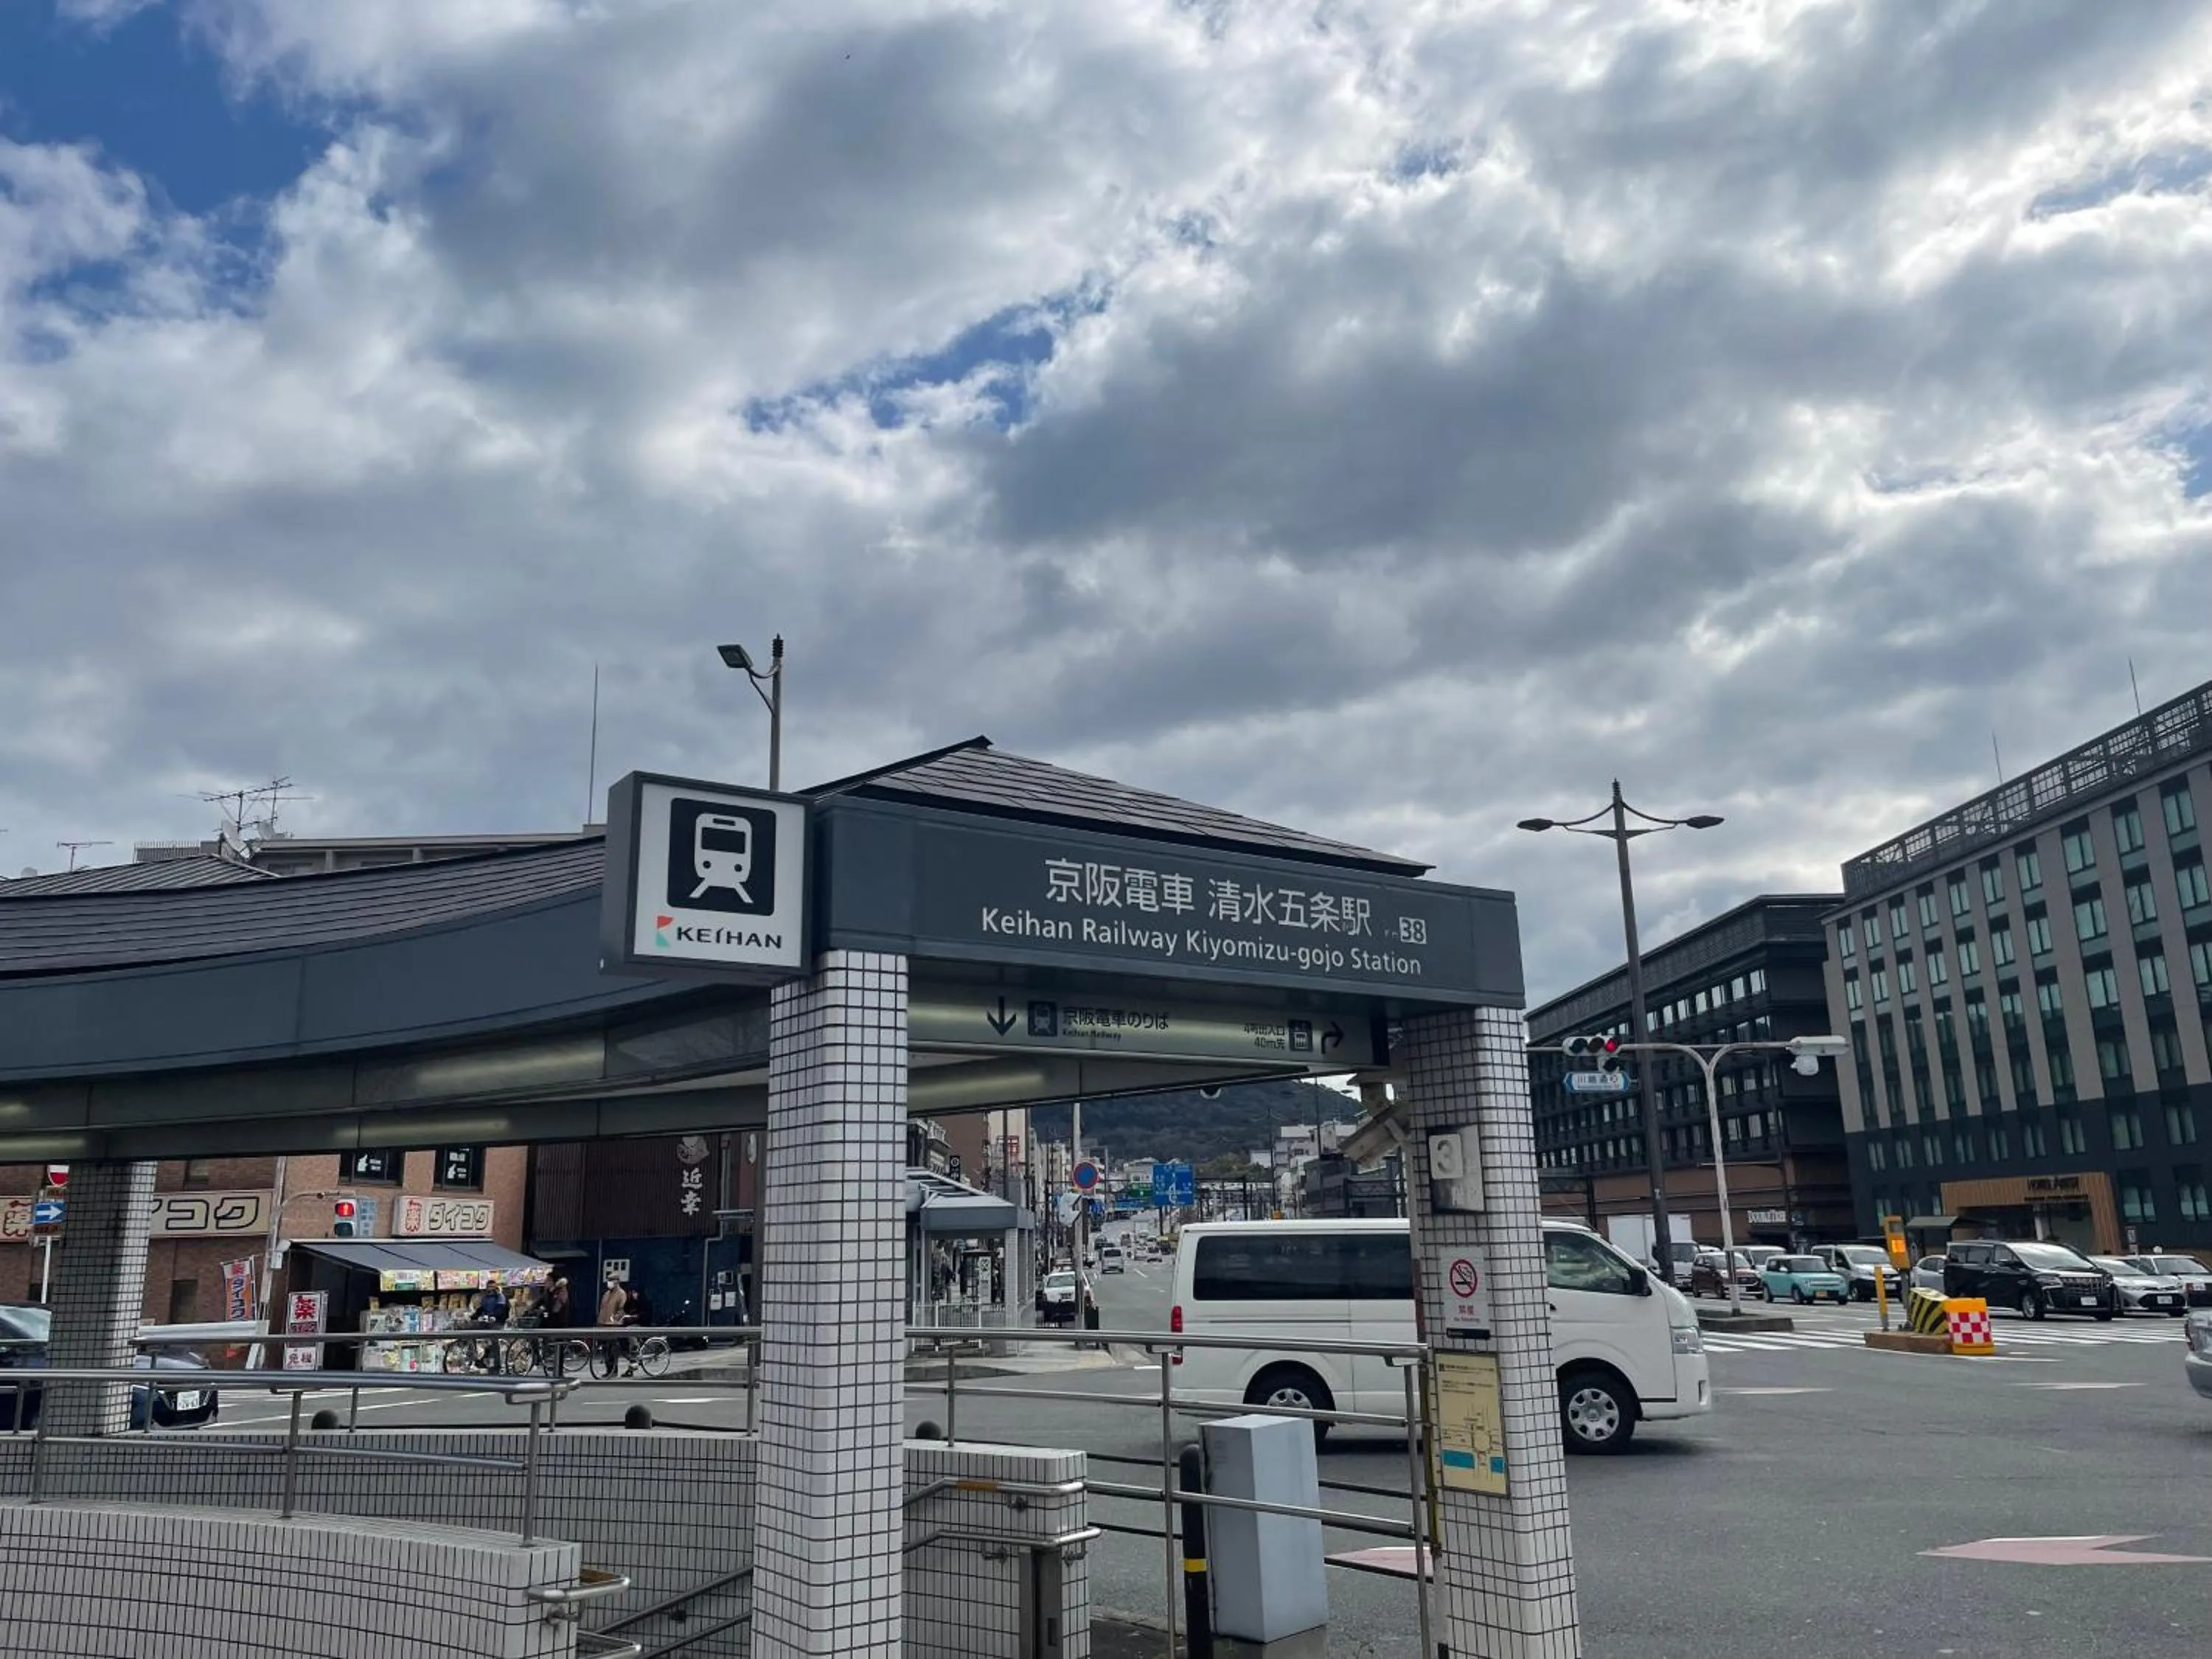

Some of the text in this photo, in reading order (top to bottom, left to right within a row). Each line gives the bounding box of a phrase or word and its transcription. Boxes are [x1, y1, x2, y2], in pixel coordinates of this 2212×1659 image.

[1045, 858, 1372, 936] 京阪電車 清水五条駅
[676, 926, 782, 949] KEIHAN
[981, 908, 1421, 975] Keihan Railway Kiyomizu-gojo Station
[1401, 918, 1425, 942] 38
[1062, 1006, 1169, 1030] 京阪電車のりば
[151, 1197, 260, 1231] コク
[428, 1203, 490, 1231] ダイコク
[295, 1295, 316, 1320] 薬
